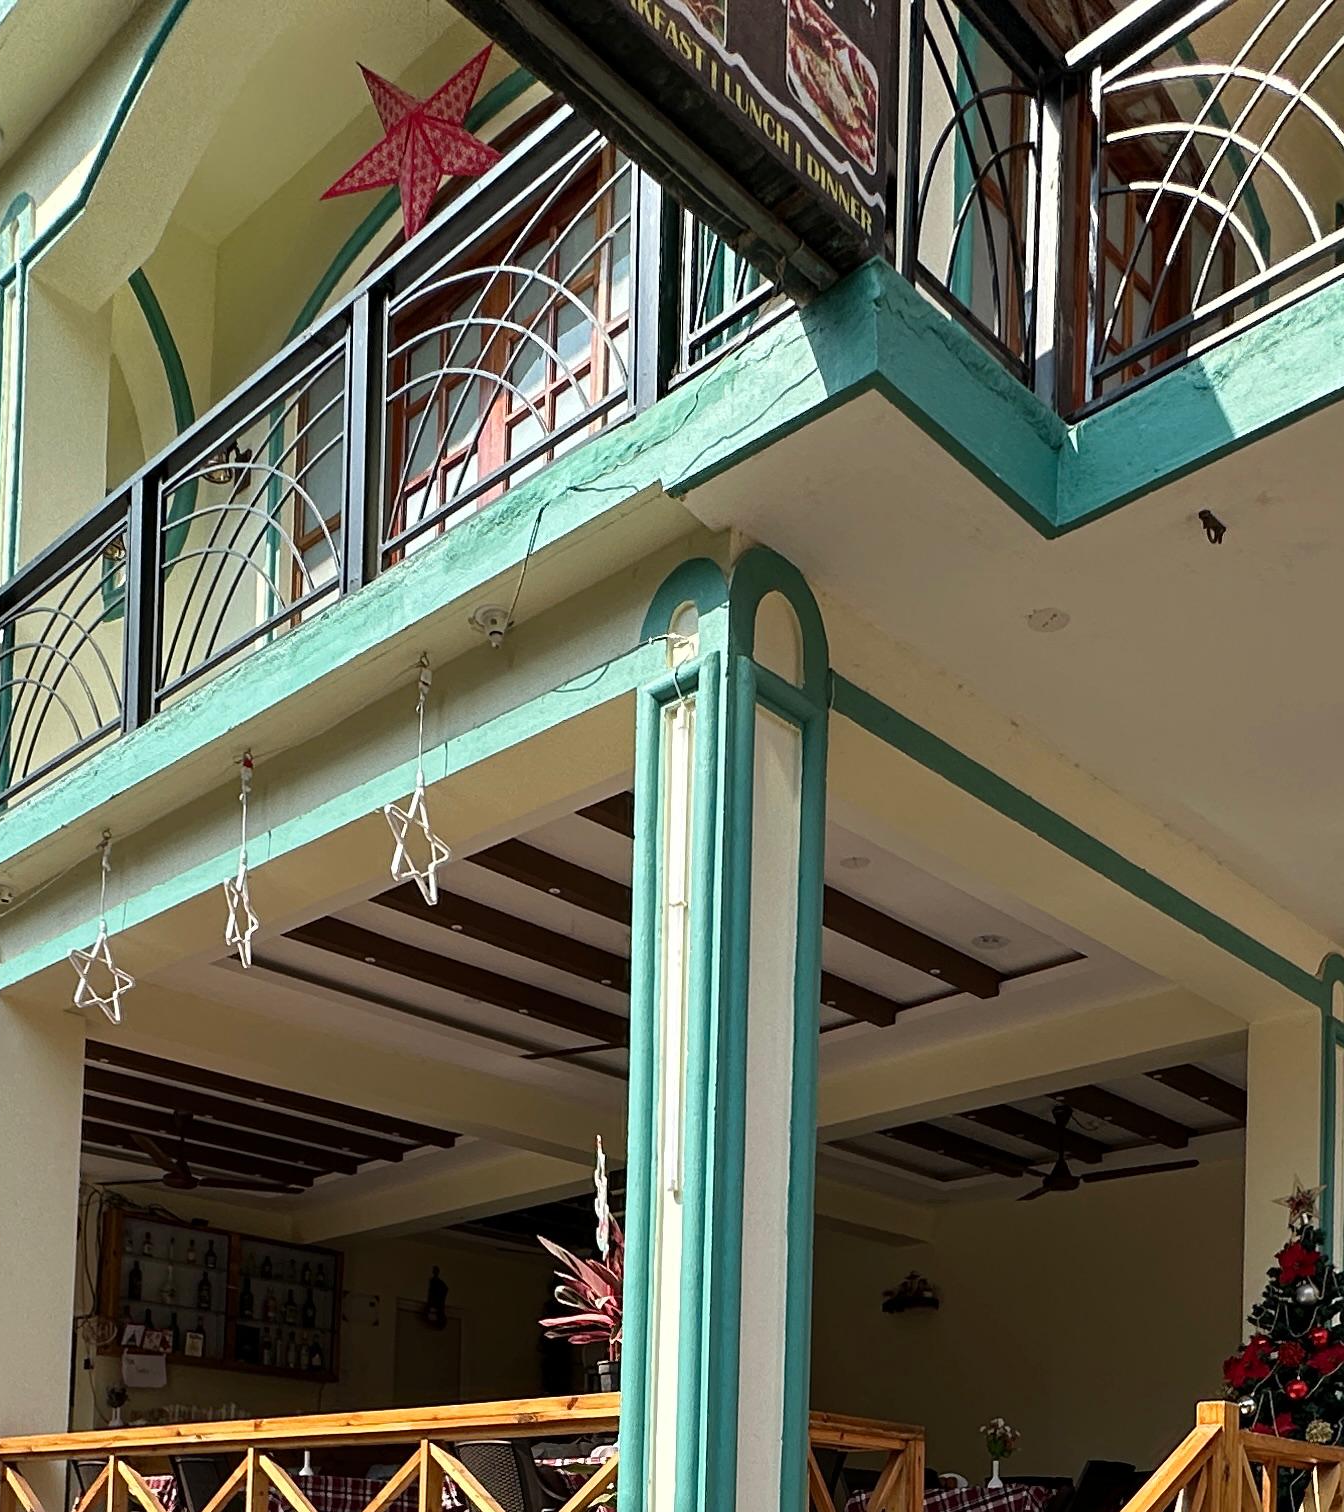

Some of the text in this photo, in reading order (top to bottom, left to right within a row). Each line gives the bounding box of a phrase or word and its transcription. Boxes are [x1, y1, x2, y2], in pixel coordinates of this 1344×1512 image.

[630, 0, 706, 71] KFAST
[724, 73, 790, 155] LUNCH
[807, 153, 872, 236] DINNER
